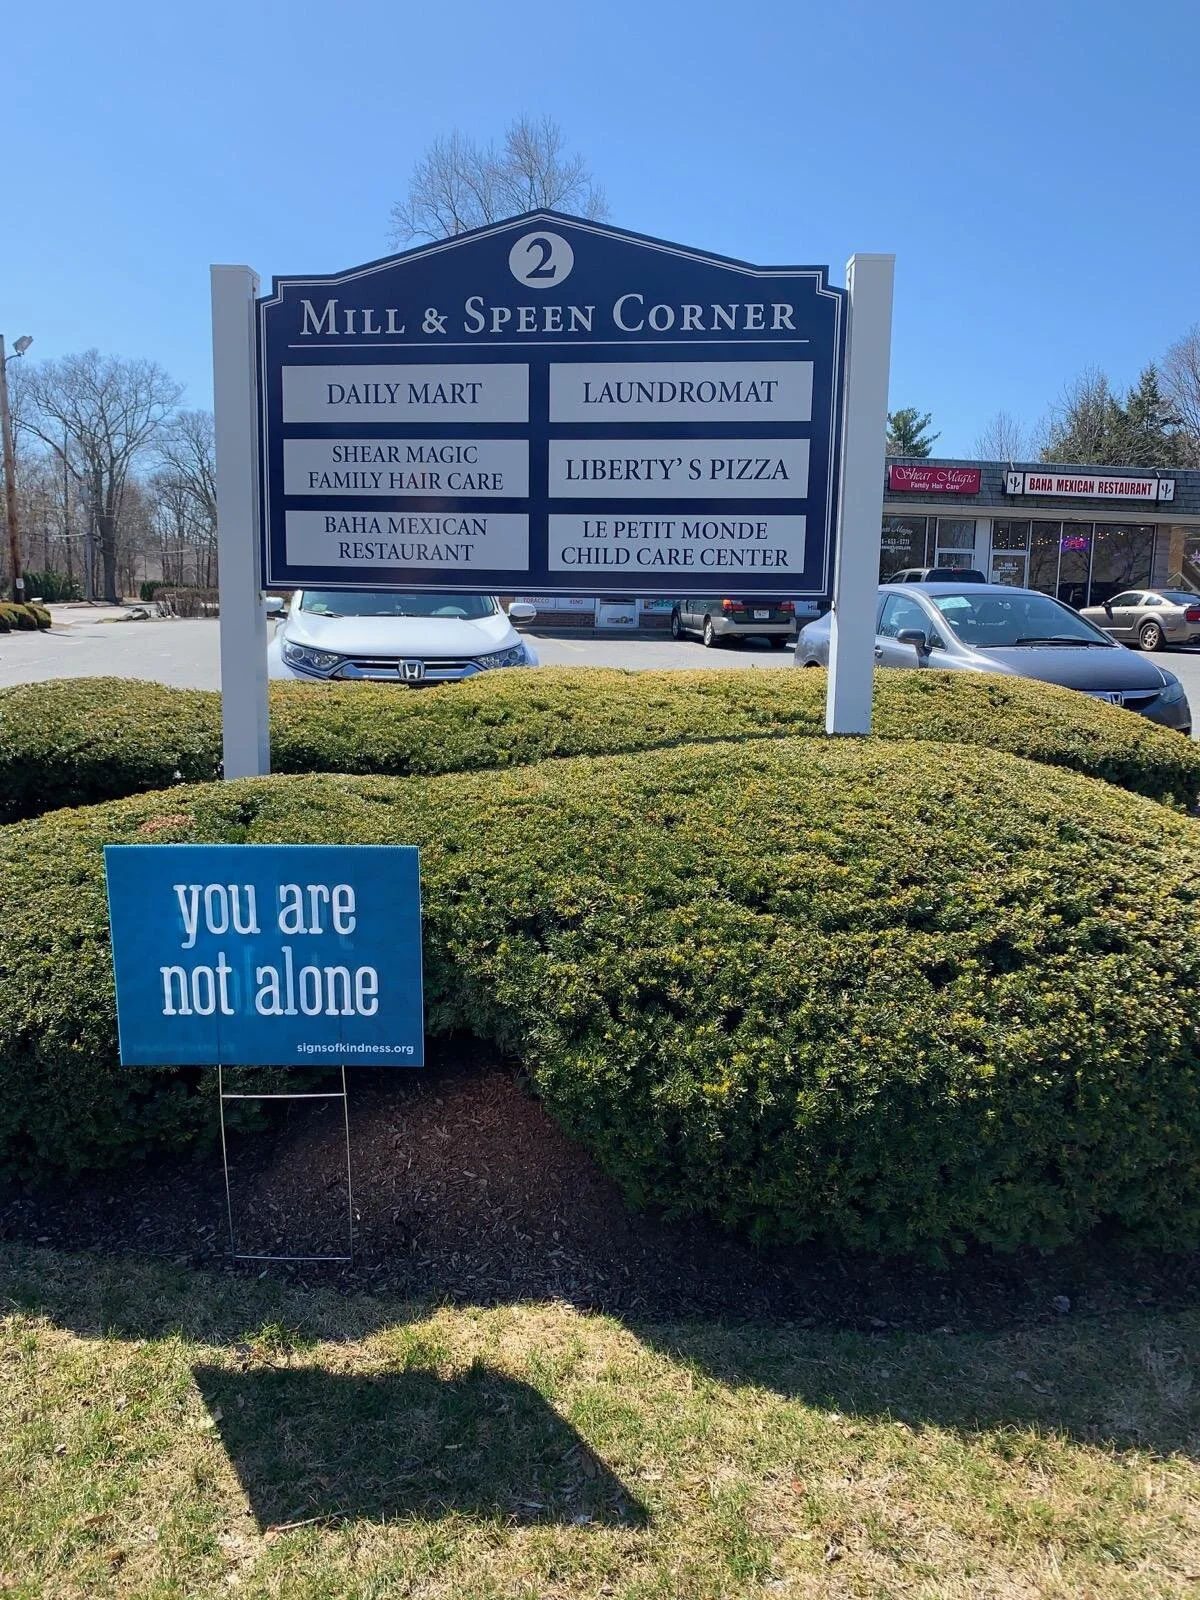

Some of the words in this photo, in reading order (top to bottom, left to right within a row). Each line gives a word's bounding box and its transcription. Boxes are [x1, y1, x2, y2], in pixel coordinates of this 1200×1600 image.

[526, 237, 558, 279] 2
[300, 300, 405, 334] MILL
[422, 308, 448, 333] &
[464, 296, 595, 333] SPEEN
[613, 294, 796, 331] CORNER
[327, 384, 400, 404] DAILY
[408, 383, 482, 403] MART
[584, 381, 778, 403] LAUNDROMAT
[333, 446, 399, 462] SHEAR
[407, 446, 477, 463] MAGIC
[710, 459, 789, 479] PIZZA
[896, 467, 933, 480] Shear
[937, 470, 976, 487] Magic
[308, 472, 382, 488] FAMILY
[389, 472, 442, 489] HAIR
[448, 473, 503, 490] CARE
[910, 481, 930, 490] Family
[1029, 478, 1053, 491] BAHA
[1056, 479, 1094, 493] MEXICAN
[1098, 482, 1152, 495] RESTAURANT
[325, 517, 382, 533] BAHA
[388, 517, 488, 535] MEXICAN
[584, 521, 607, 538] LE
[615, 522, 675, 538] PETIT
[681, 522, 767, 539] MONDE
[339, 542, 473, 561] RESTAURANT
[562, 547, 630, 564] CHILD
[637, 548, 694, 565] CARE
[700, 549, 788, 566] CENTER
[173, 884, 260, 948] you
[279, 884, 355, 934] are
[160, 952, 234, 1015] not
[255, 946, 378, 1016] alone
[297, 1043, 413, 1054] signsofkindness.org
